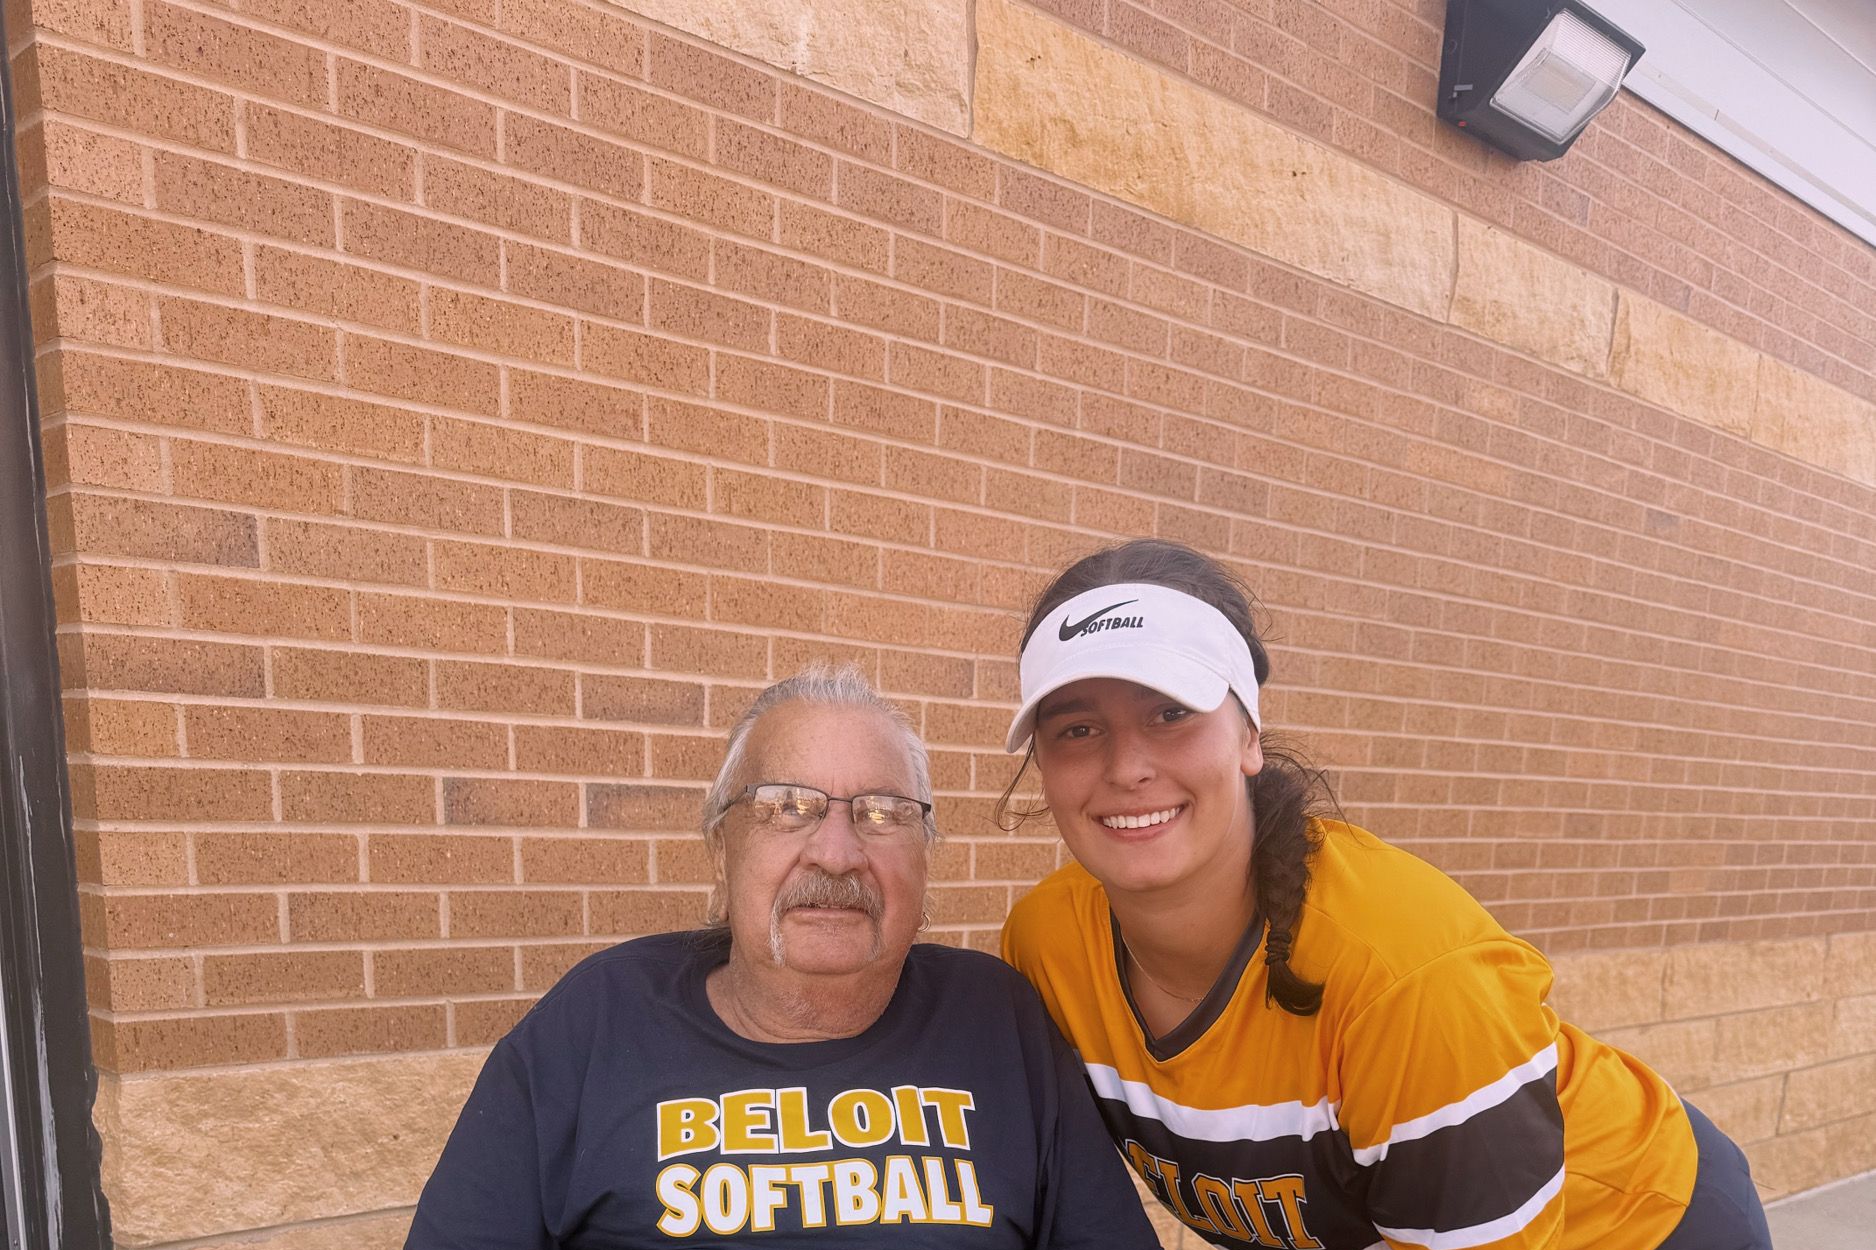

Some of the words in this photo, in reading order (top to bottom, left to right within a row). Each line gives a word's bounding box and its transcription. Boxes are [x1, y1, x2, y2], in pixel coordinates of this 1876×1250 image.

[1080, 616, 1144, 637] SOFTBALL
[657, 1085, 976, 1161] BELOIT
[655, 1155, 994, 1238] SOFTBALL
[1124, 1138, 1326, 1250] ELOIT
